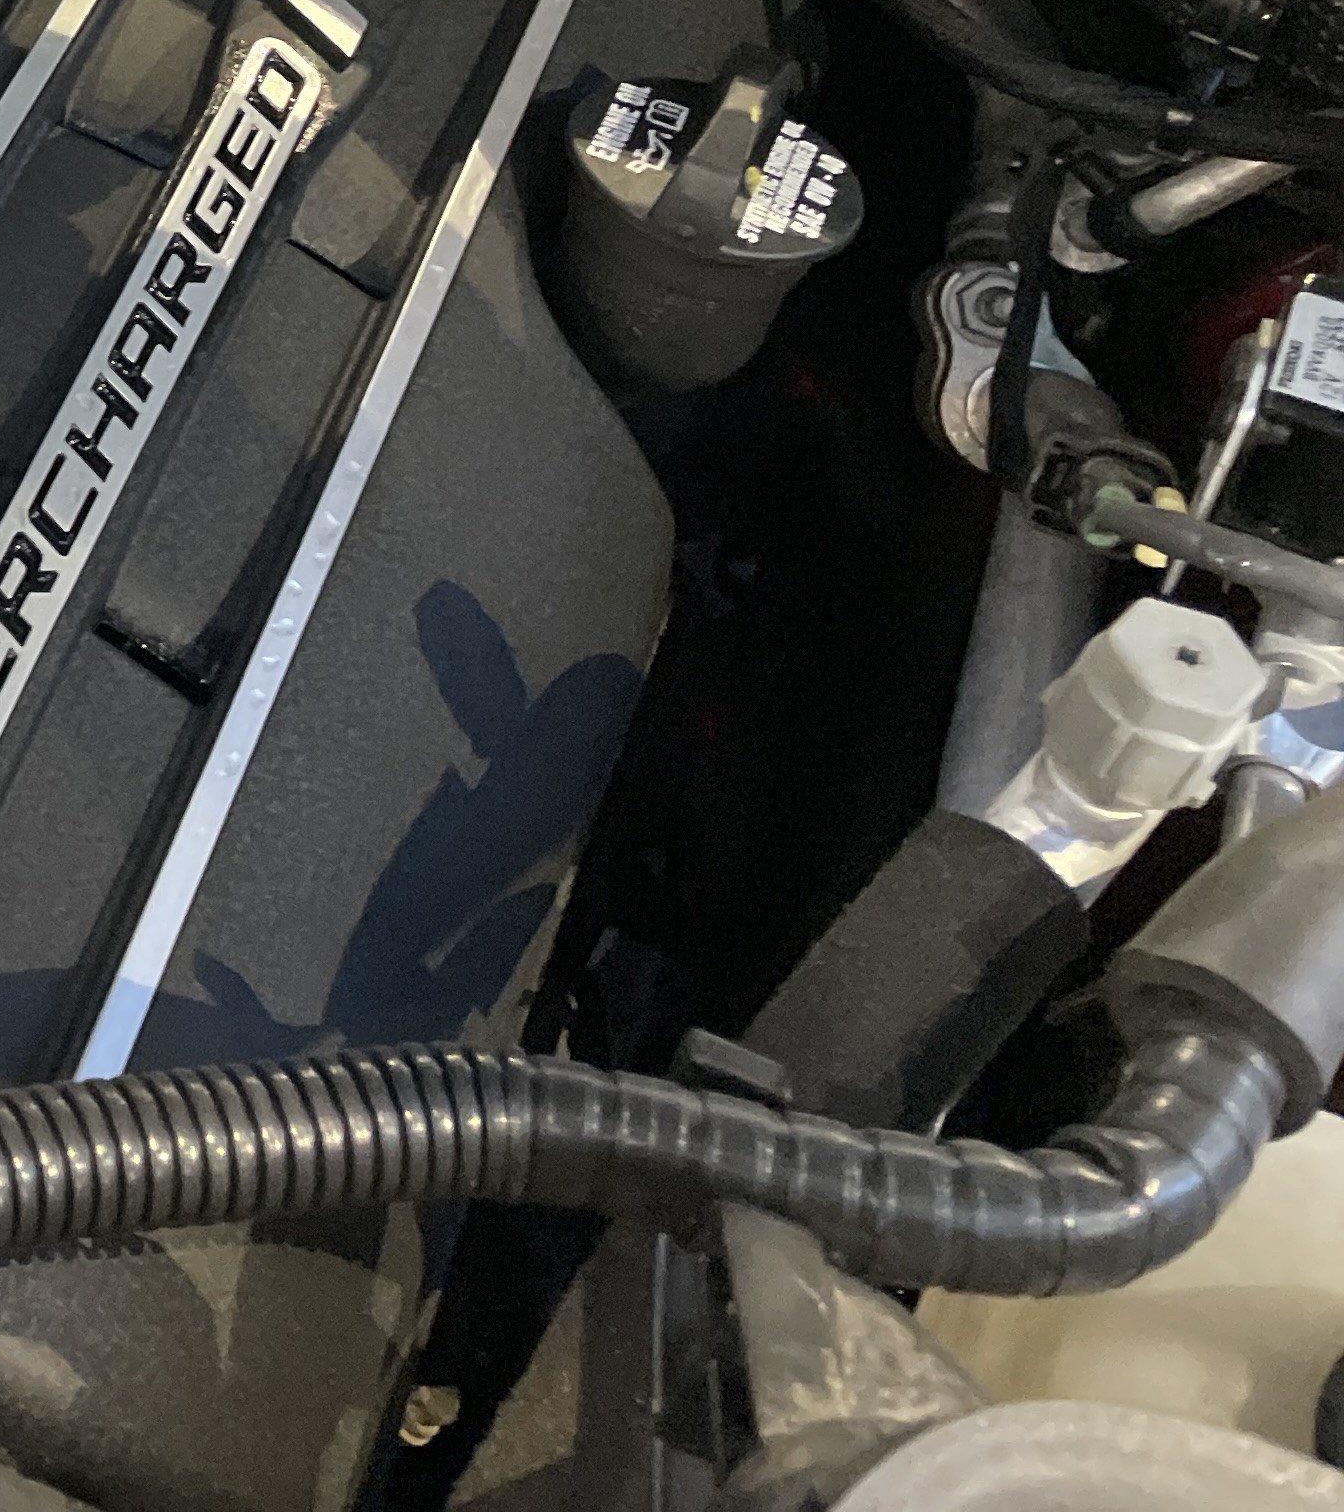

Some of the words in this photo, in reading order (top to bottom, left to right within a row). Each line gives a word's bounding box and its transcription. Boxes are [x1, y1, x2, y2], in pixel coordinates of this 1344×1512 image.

[585, 102, 642, 163] ENGINE
[614, 82, 653, 107] OIL
[736, 175, 779, 244] SYNTHETIC
[762, 135, 796, 180] ENGINE
[780, 120, 807, 139] OIL
[764, 140, 819, 235] RECOMMENDED
[790, 203, 827, 239] SAE
